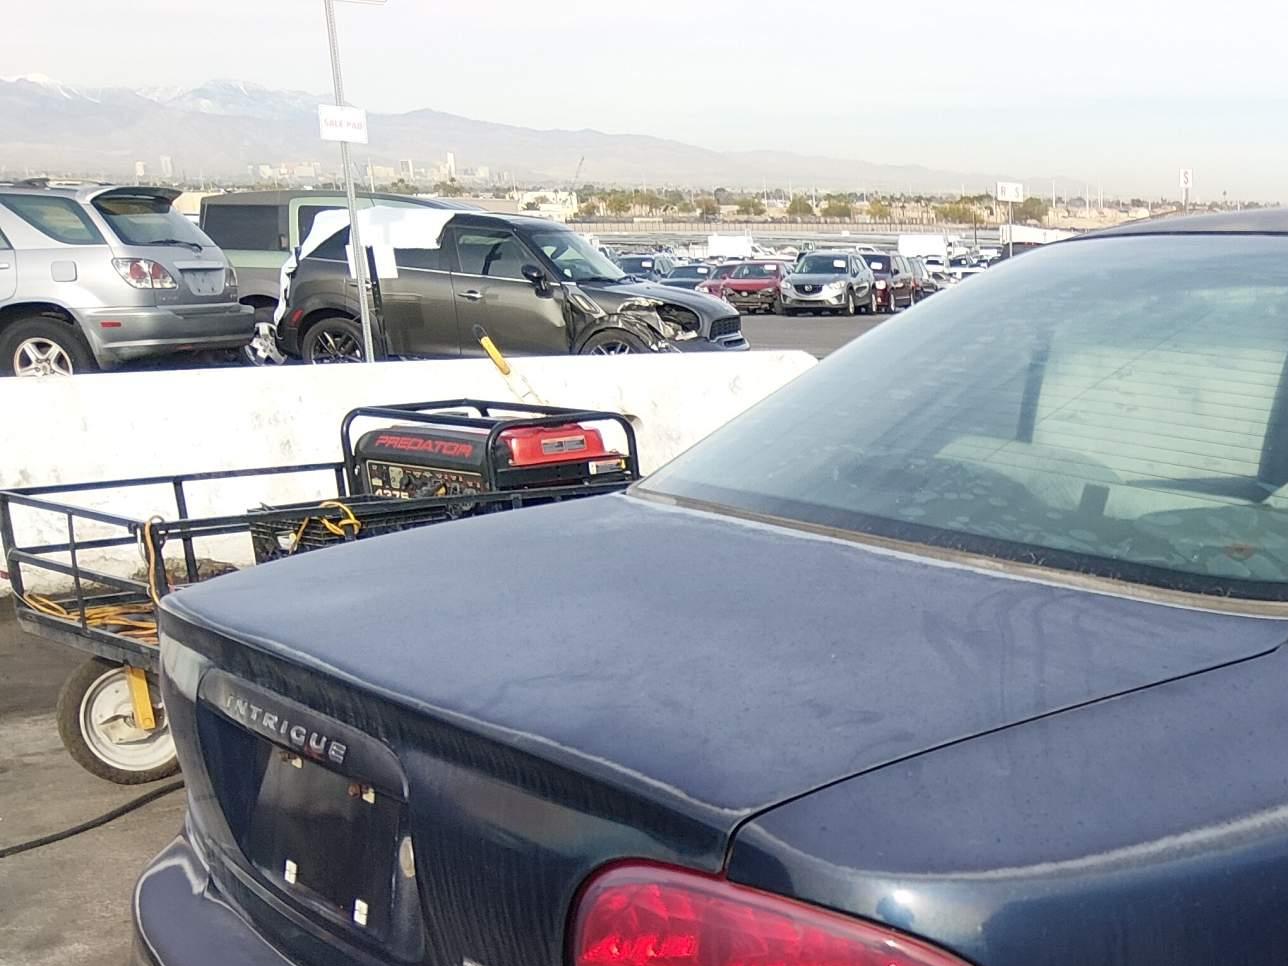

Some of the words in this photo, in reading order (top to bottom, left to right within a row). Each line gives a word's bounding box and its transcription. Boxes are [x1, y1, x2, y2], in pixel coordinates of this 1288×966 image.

[1183, 170, 1189, 185] S
[375, 435, 474, 458] PREDATOR
[225, 695, 347, 764] INTRIGUE
